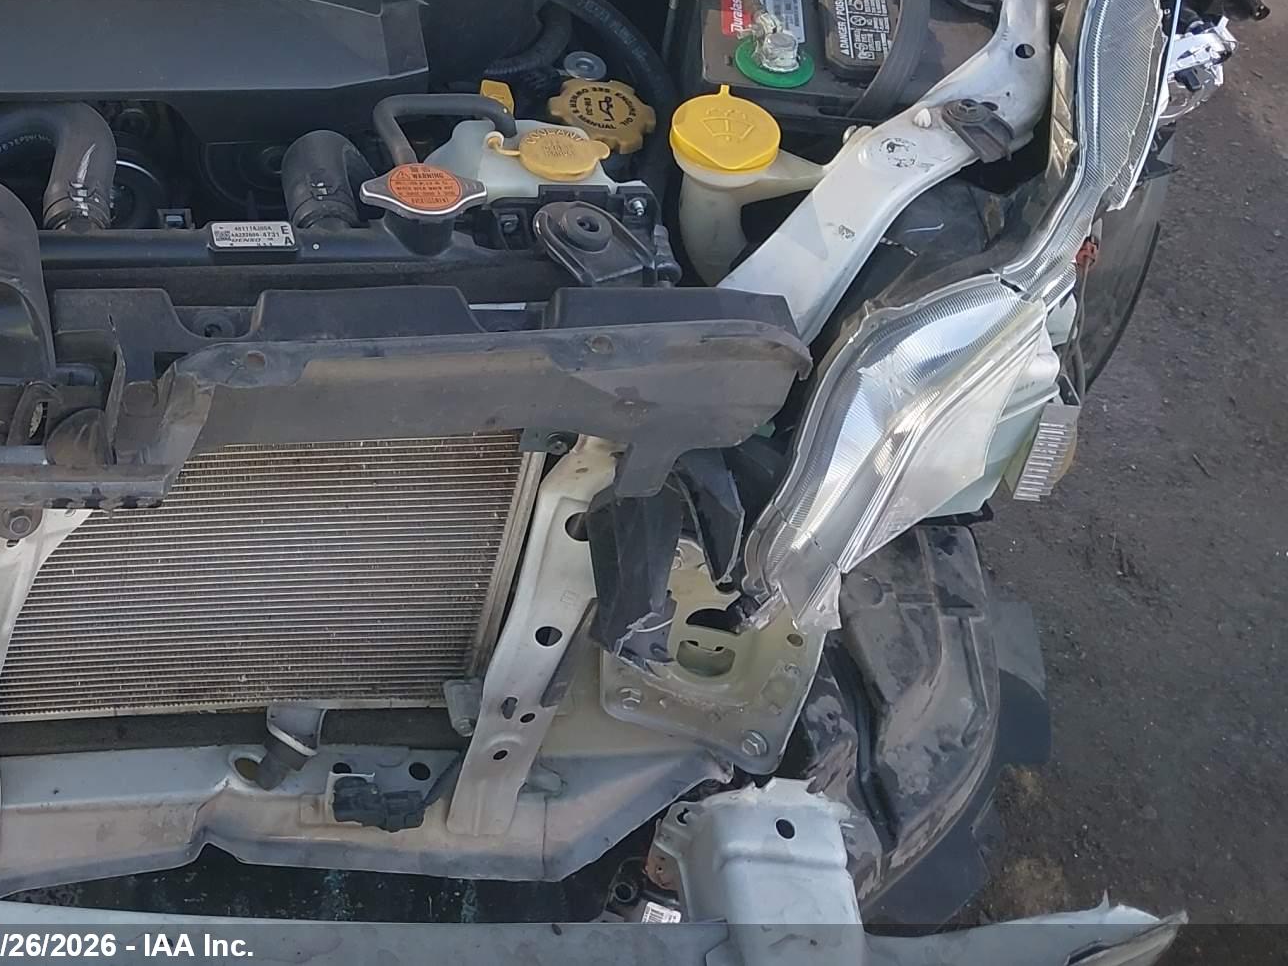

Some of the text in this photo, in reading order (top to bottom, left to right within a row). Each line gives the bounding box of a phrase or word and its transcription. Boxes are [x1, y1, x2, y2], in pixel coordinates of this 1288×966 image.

[837, 20, 849, 49] DANGER
[615, 92, 636, 126] ENGINE OIL
[578, 114, 616, 130] MANUAL
[525, 128, 589, 144] COOLANT
[280, 225, 289, 234] E
[284, 237, 293, 245] A
